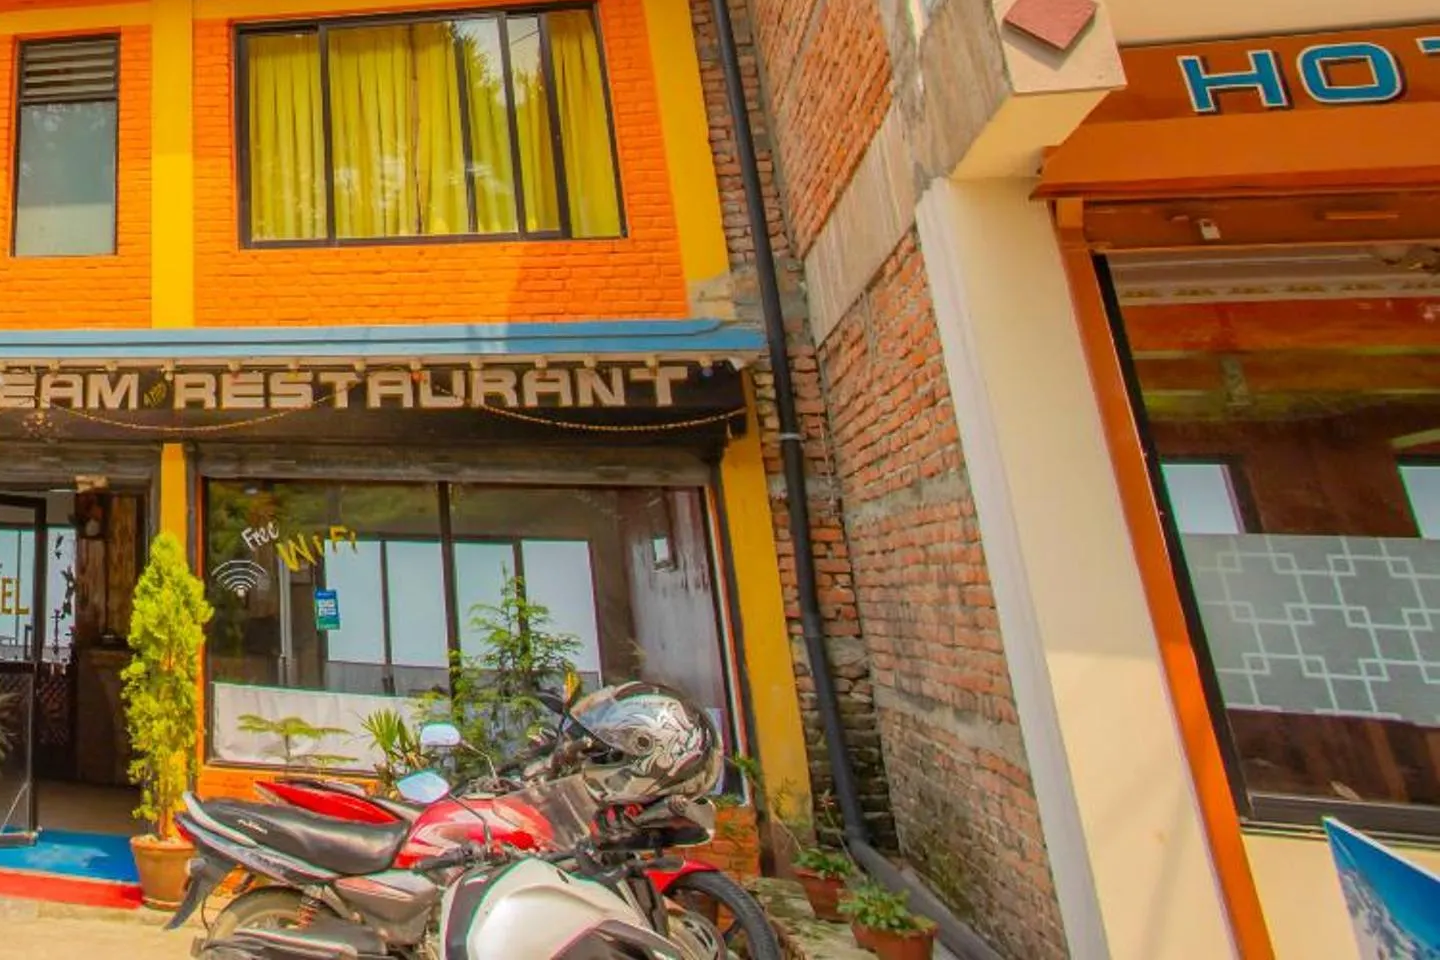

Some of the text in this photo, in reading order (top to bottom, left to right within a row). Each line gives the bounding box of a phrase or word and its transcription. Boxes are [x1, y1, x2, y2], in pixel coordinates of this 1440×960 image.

[1176, 36, 1440, 112] HO
[174, 366, 688, 409] RESTAURANT
[241, 520, 280, 552] Free
